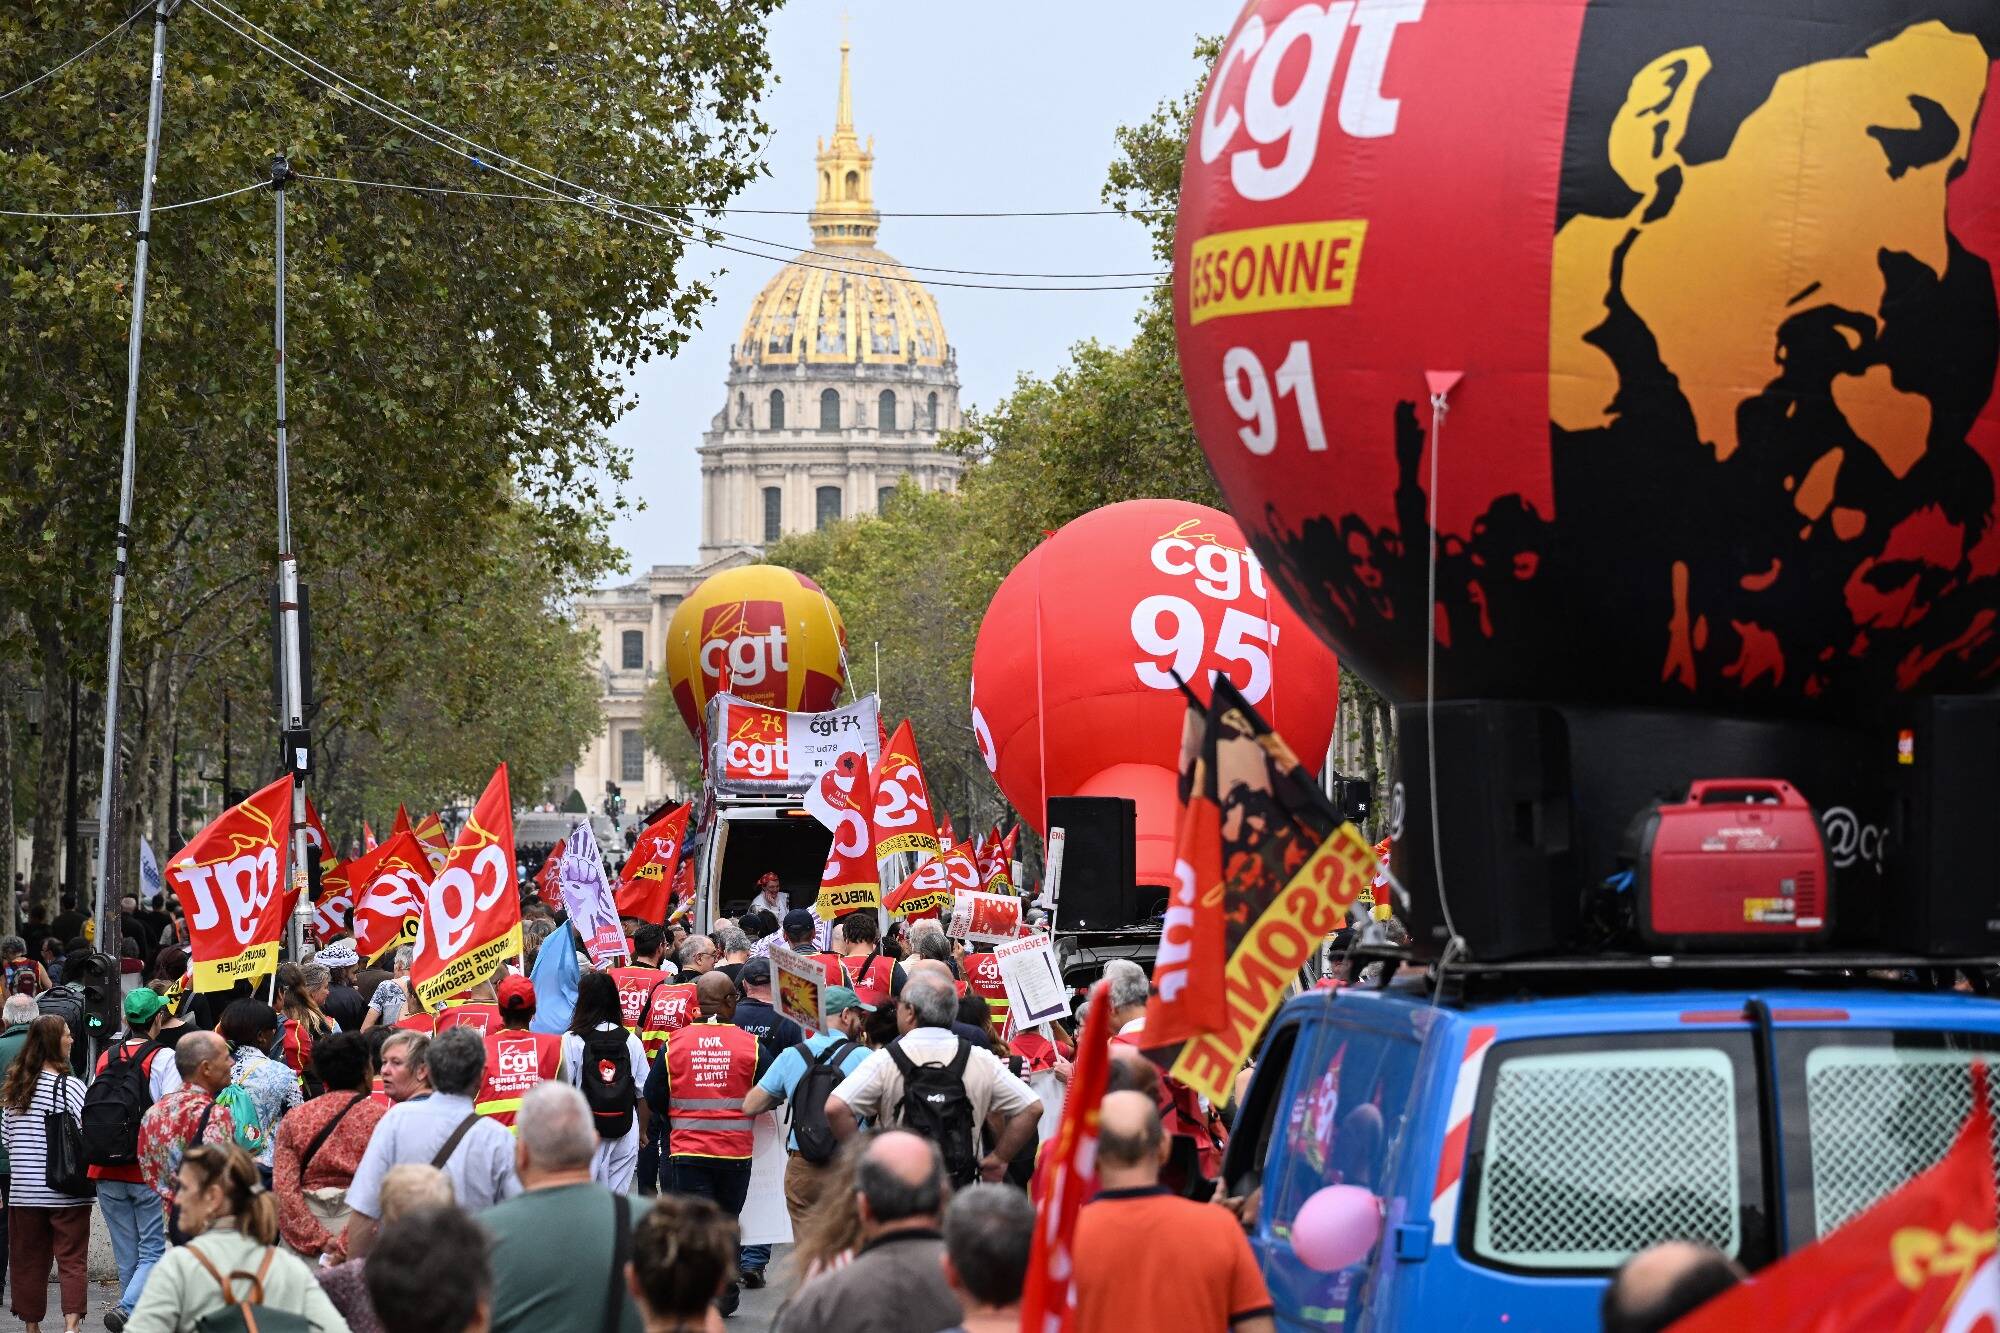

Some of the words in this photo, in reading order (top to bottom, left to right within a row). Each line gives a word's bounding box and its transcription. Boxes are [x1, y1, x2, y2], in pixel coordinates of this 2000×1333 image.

[1200, 0, 1428, 201] cgt
[1192, 237, 1353, 309] ESSONNE
[1222, 340, 1328, 457] 91
[1150, 537, 1268, 600] cgt
[700, 625, 789, 686] cgt
[1130, 594, 1280, 708] 95
[730, 717, 768, 744] la
[761, 713, 783, 733] 78
[809, 717, 839, 736] cgt
[726, 737, 788, 777] cgt
[997, 946, 1011, 959] EN
[619, 989, 648, 1009] cgt
[653, 998, 687, 1016] cgt
[653, 1015, 677, 1023] AIRBUS
[698, 1036, 723, 1048] POUR
[500, 1051, 538, 1073] cgt
[488, 1076, 516, 1085] Santé
[494, 1082, 531, 1092] Sociale
